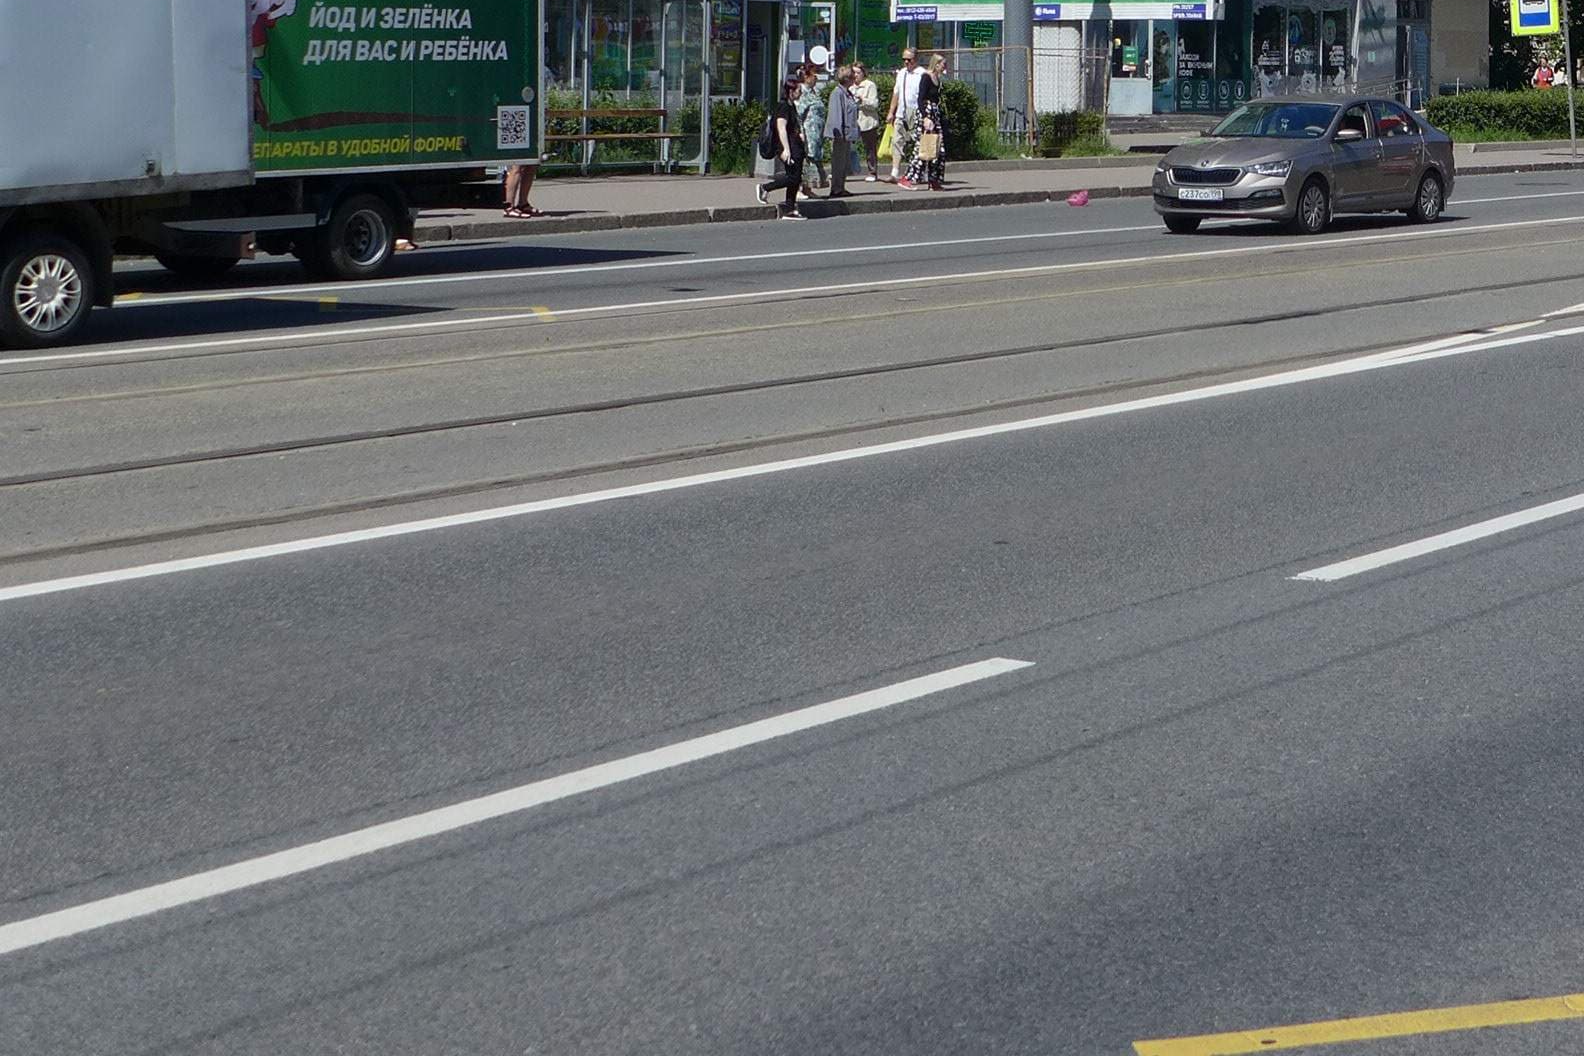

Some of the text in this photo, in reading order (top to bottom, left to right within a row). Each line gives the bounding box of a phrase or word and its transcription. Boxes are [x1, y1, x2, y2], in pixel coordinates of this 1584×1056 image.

[309, 1, 472, 32] ЙОД И ЗЕЛЁНКА
[302, 35, 508, 65] ДЛЯ ВАС И РЕБЁНКА
[254, 134, 465, 159] ЕПАРАТЫ В УДОБНОЙ ФОРМЕ
